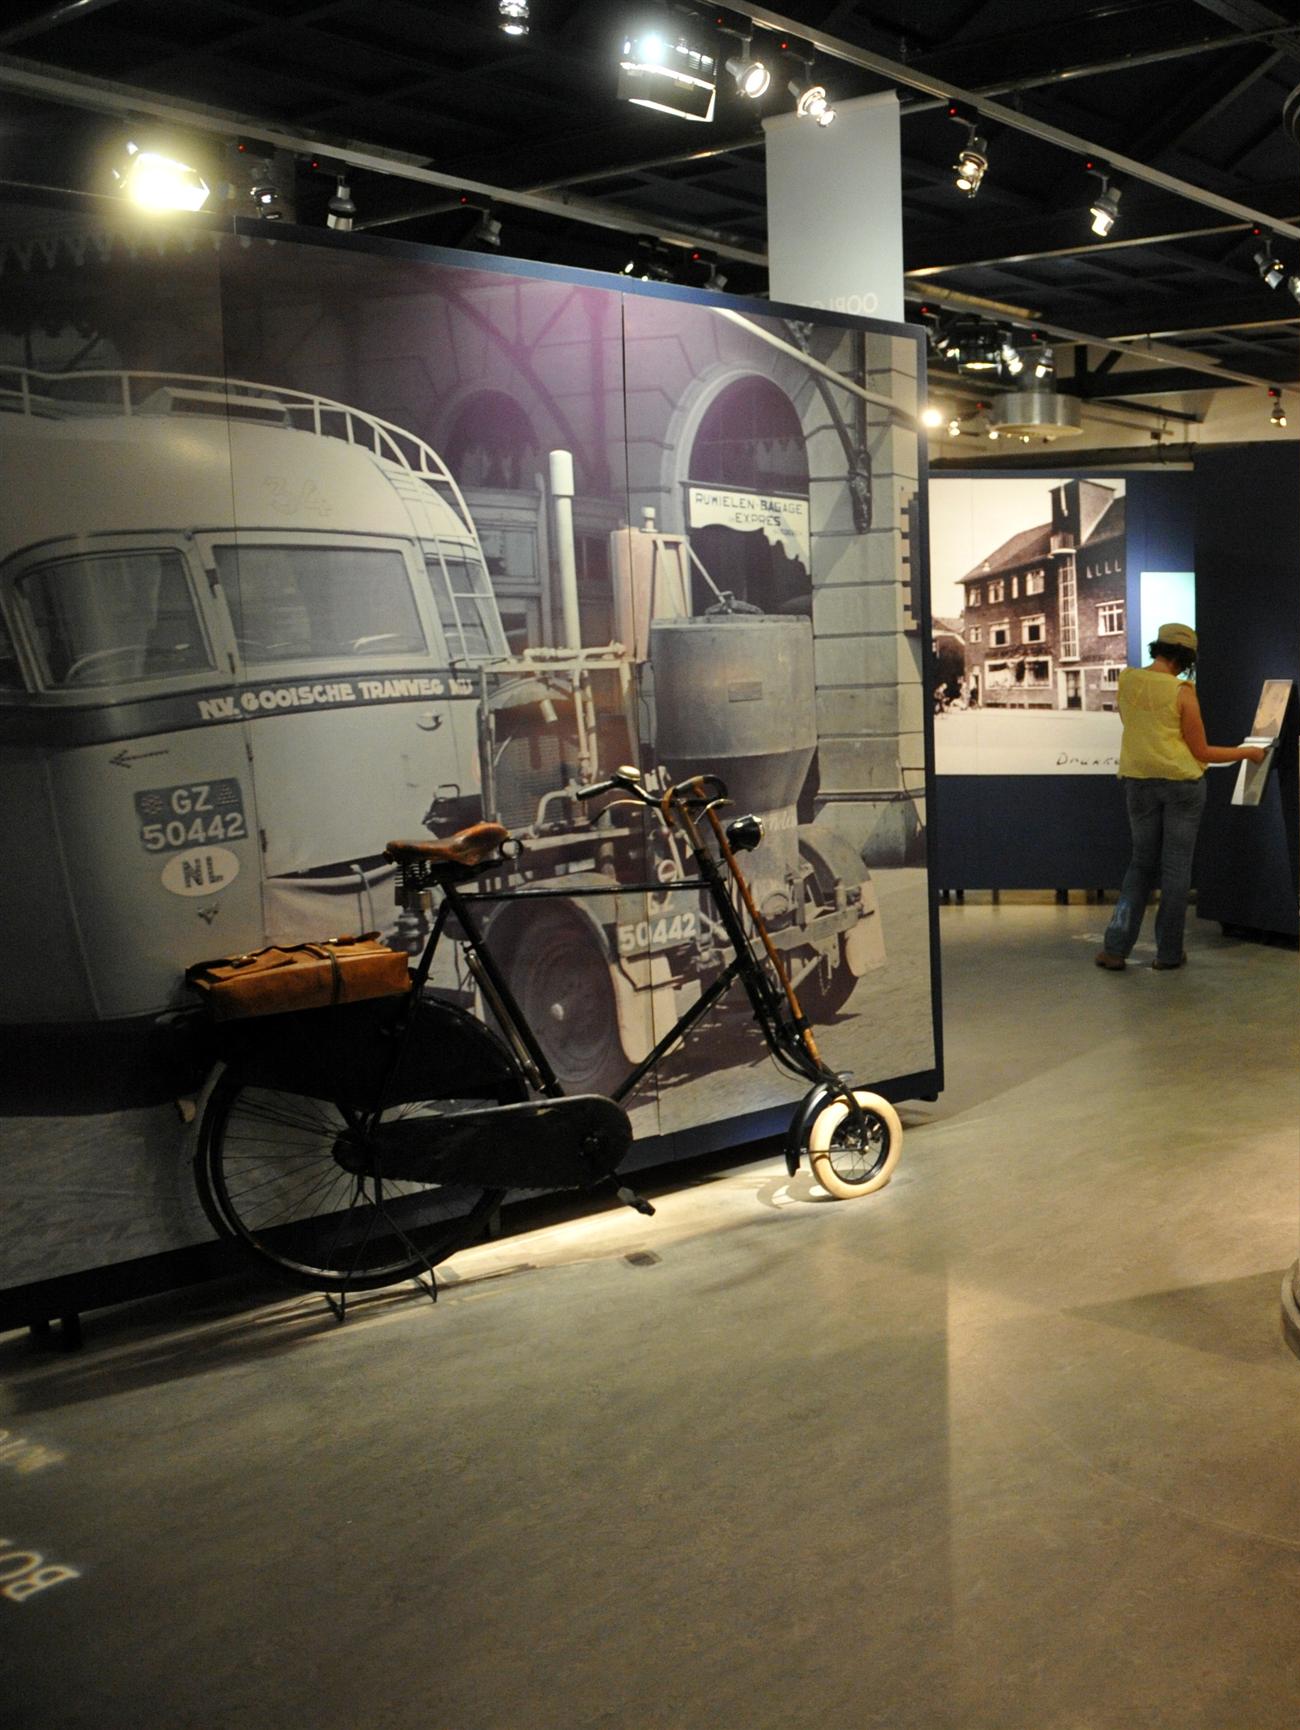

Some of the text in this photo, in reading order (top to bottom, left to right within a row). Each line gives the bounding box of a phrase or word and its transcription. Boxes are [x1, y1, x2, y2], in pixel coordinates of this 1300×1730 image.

[241, 684, 355, 711] GOOISCHE
[171, 785, 213, 815] GZ
[143, 812, 245, 850] 50442
[182, 856, 224, 889] NL
[618, 911, 697, 951] 50442
